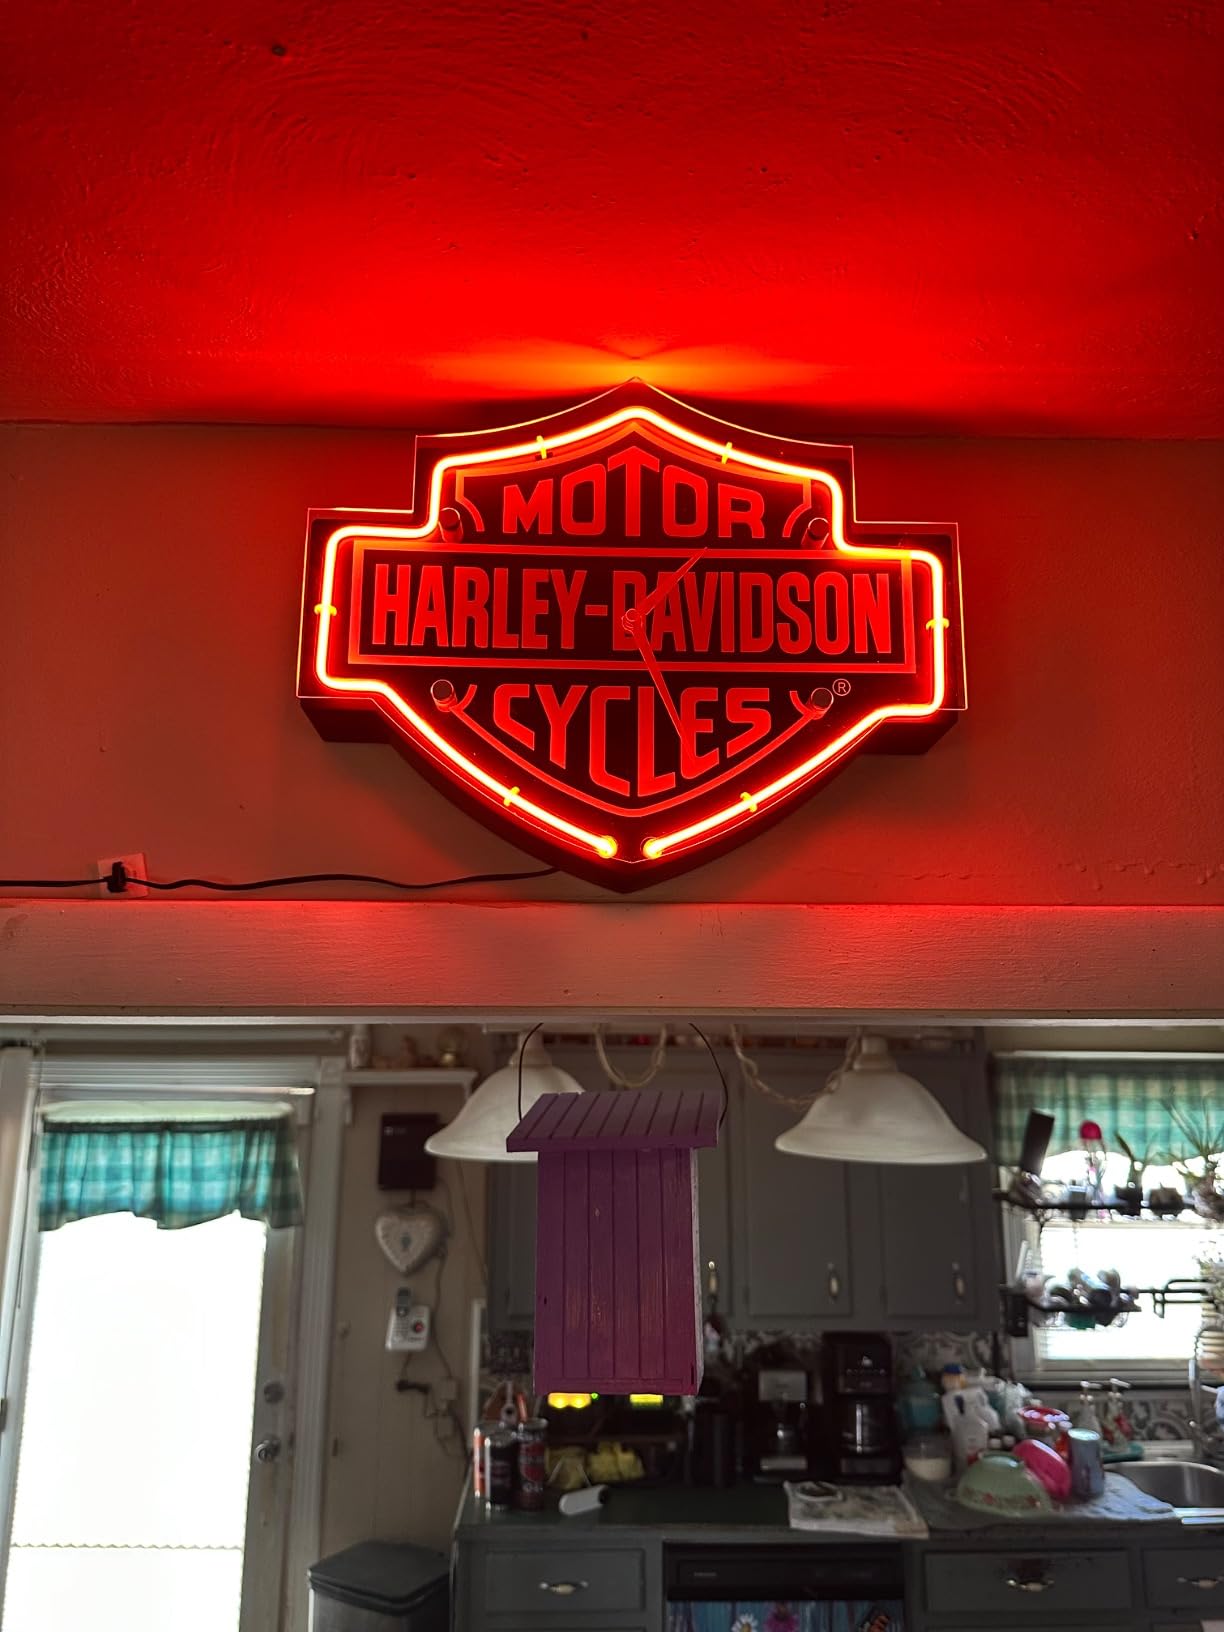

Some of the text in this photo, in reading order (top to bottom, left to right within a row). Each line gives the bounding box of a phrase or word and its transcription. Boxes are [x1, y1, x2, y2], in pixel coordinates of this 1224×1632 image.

[502, 445, 766, 539] MOTOR
[372, 563, 892, 655] HARLEY-DAVIDSON
[493, 683, 772, 797] CYCLES
